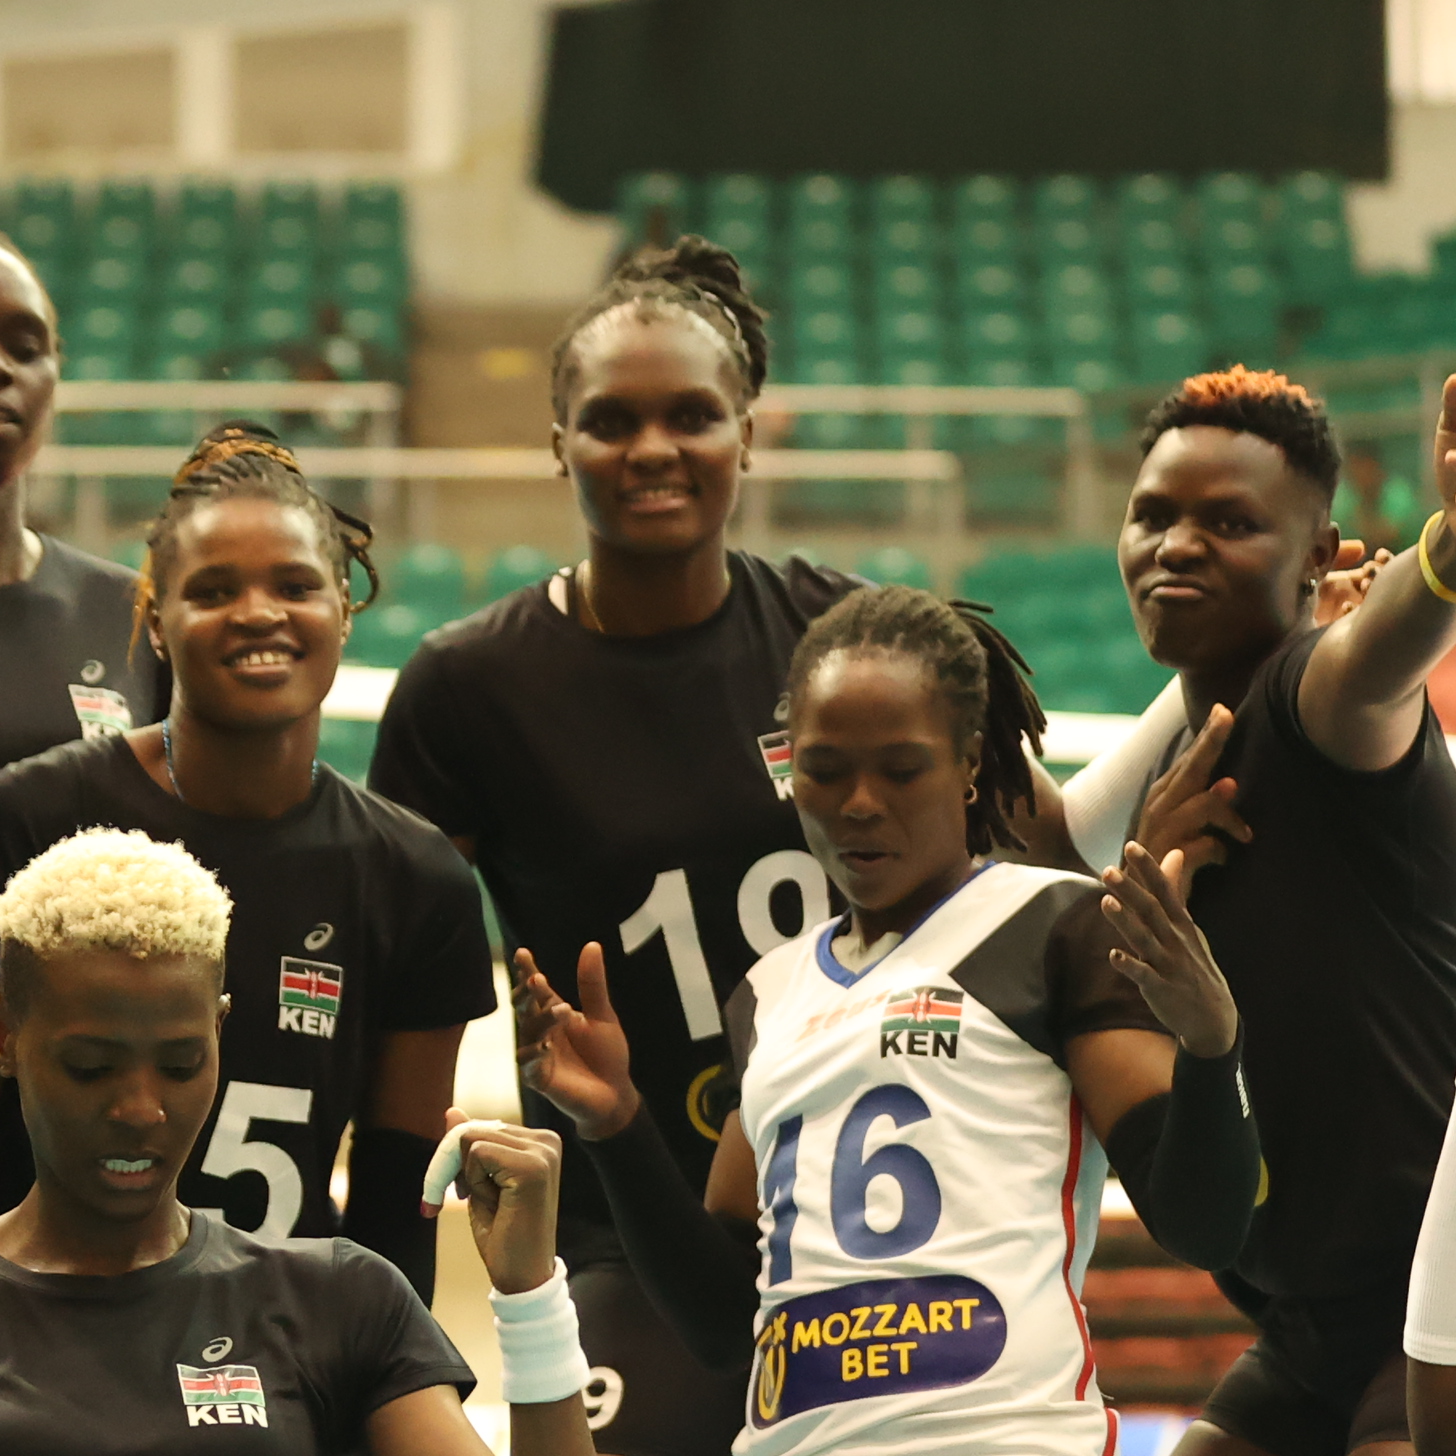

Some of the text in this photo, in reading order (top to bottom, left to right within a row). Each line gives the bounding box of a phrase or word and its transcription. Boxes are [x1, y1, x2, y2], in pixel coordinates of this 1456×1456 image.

[278, 1008, 336, 1039] KEN
[879, 1030, 959, 1060] KEN
[764, 1083, 942, 1287] 16
[791, 1298, 980, 1354] MOZZART
[841, 1342, 918, 1382] BET
[185, 1403, 269, 1428] KEN
